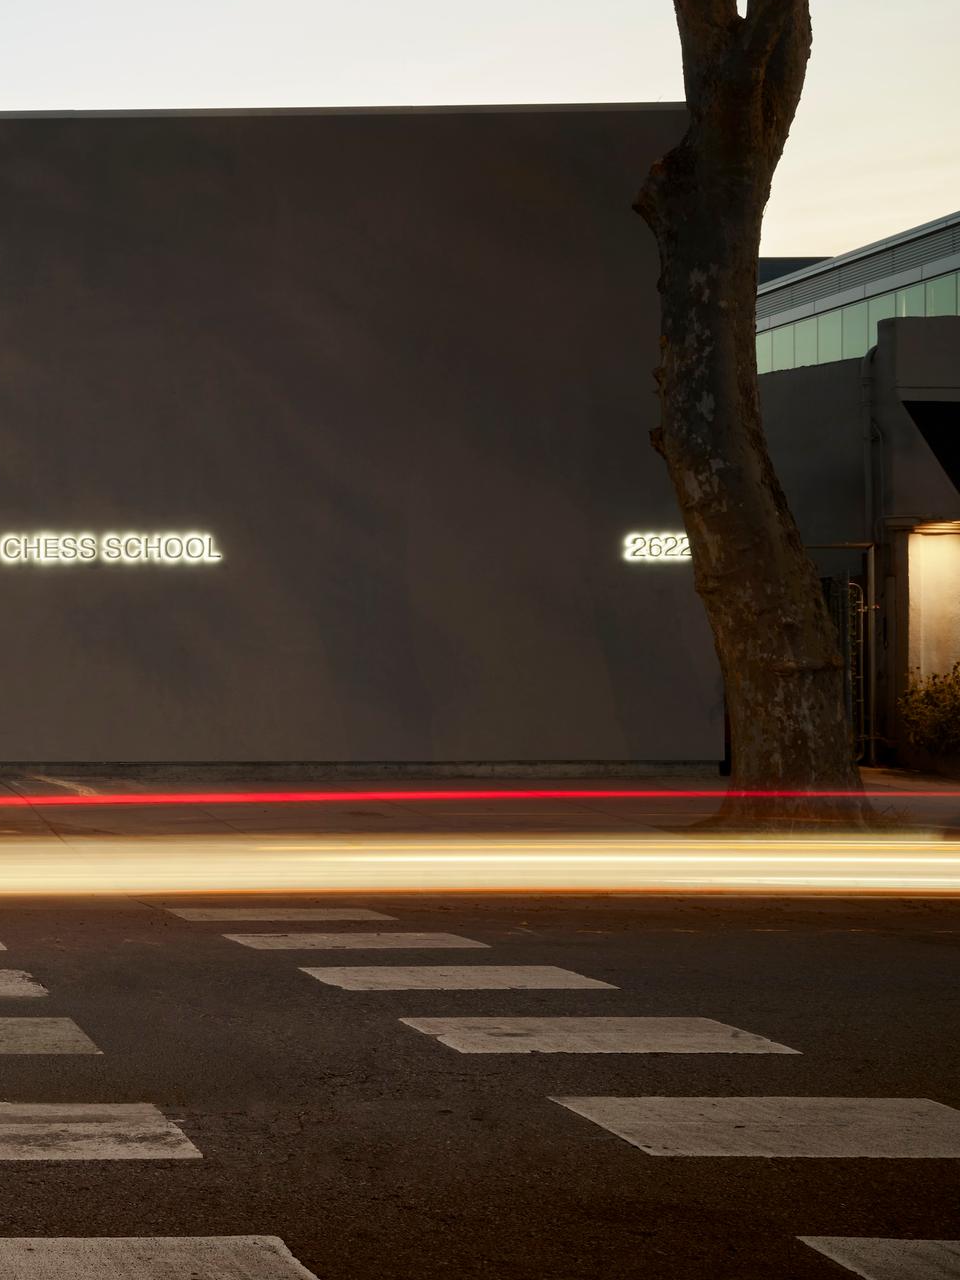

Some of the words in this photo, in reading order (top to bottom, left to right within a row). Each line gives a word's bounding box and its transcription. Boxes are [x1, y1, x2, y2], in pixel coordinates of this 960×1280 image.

[2, 537, 97, 560] CHESS
[104, 537, 222, 560] SCHOOL
[631, 536, 692, 557] 2622
